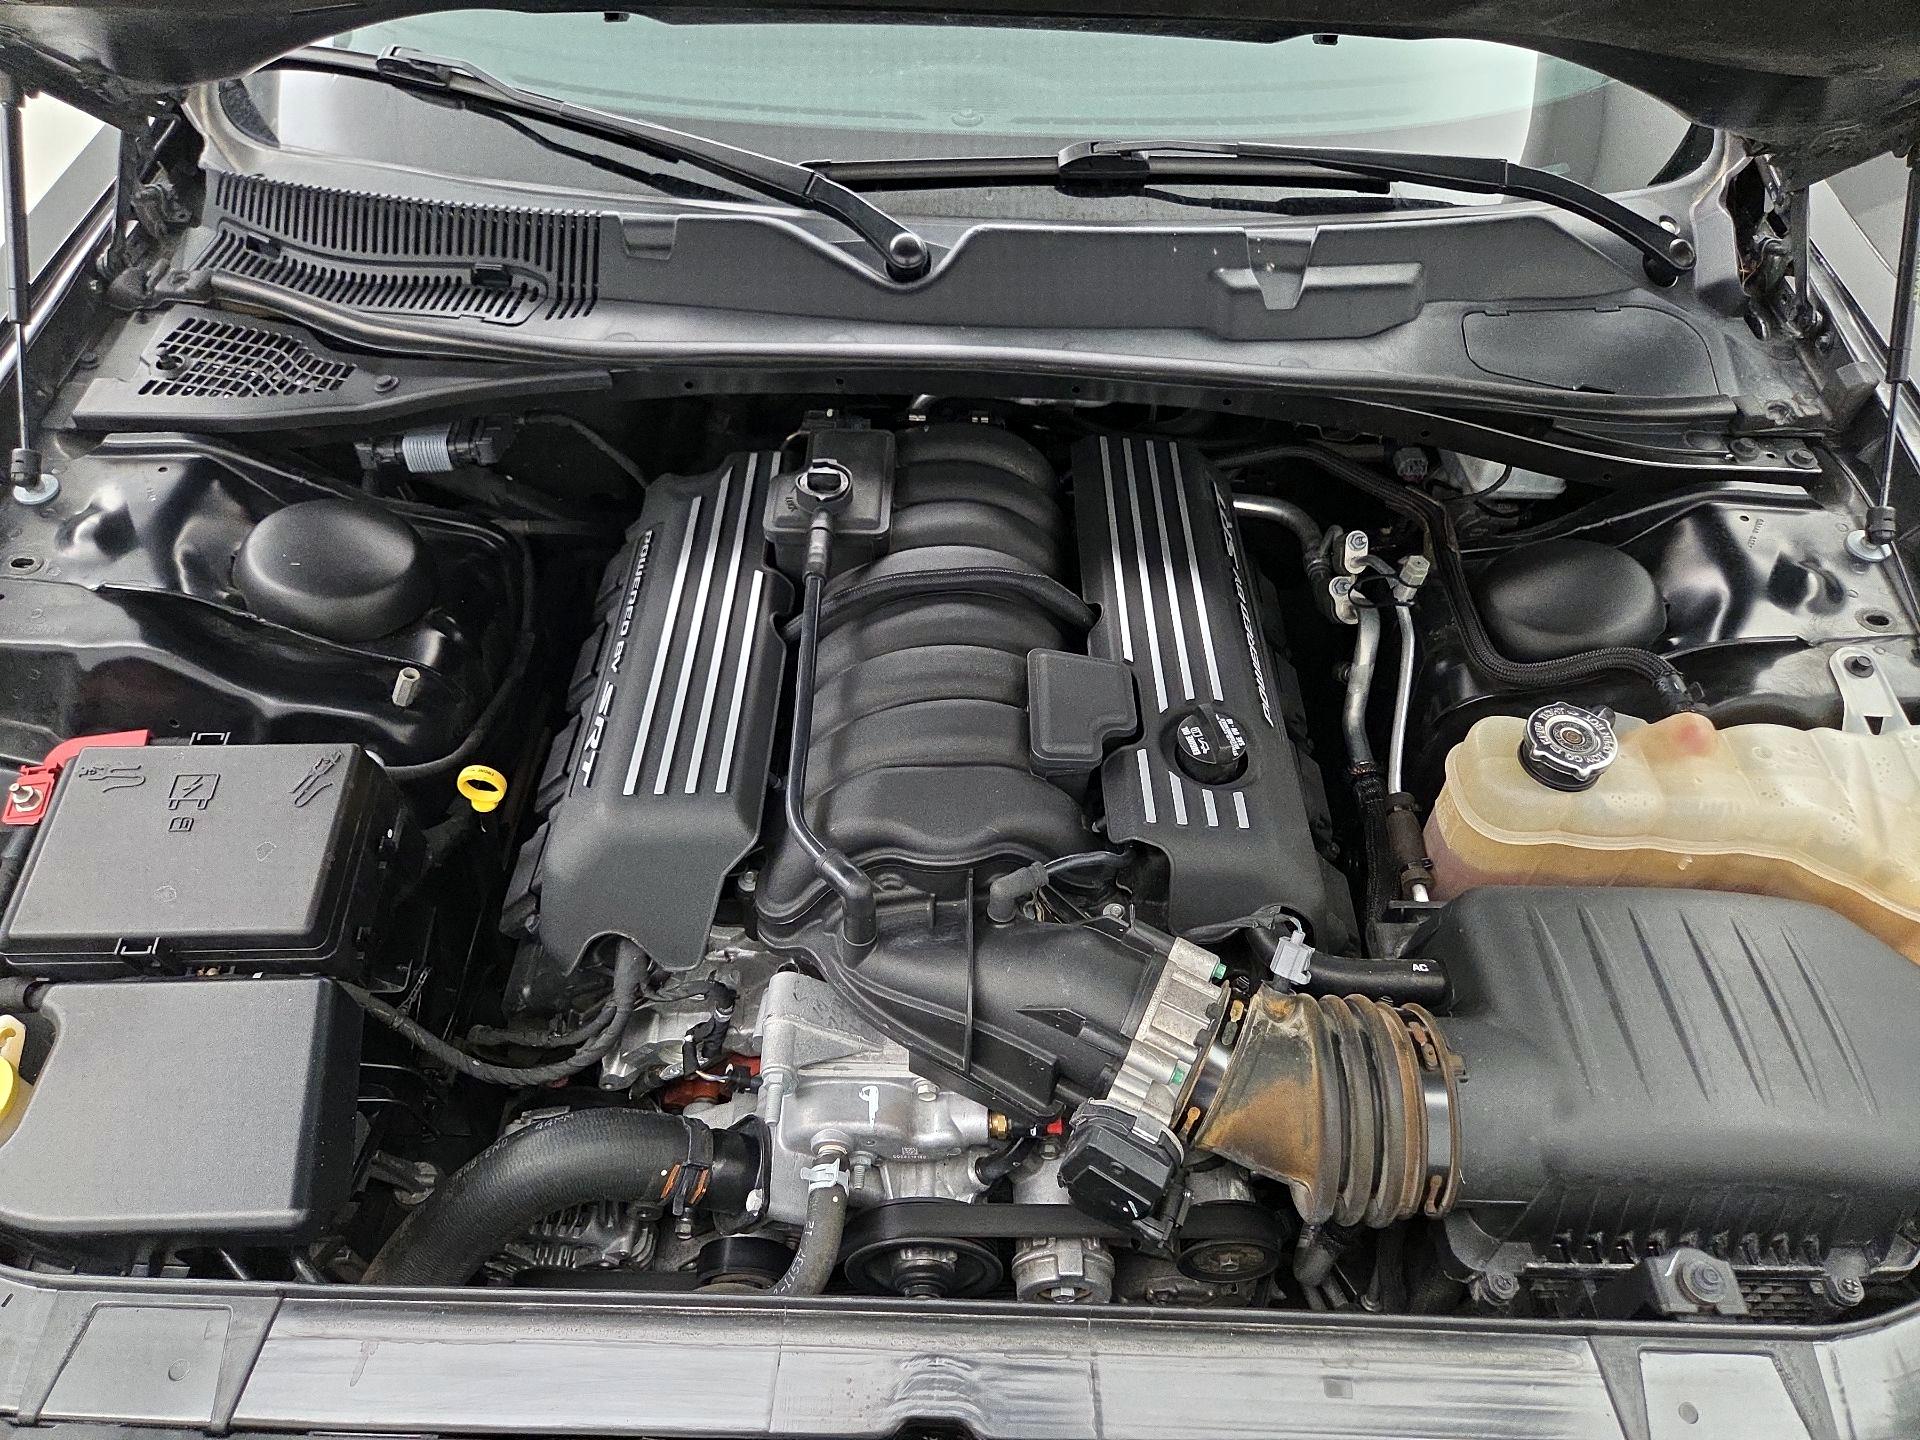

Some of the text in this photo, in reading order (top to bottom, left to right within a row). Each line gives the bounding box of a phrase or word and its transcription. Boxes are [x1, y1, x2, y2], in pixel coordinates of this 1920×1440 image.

[1212, 480, 1240, 570] SRT
[582, 530, 653, 787] POWERED BY SRT
[1185, 735, 1202, 756] ENGINE
[1412, 962, 1429, 973] AC
